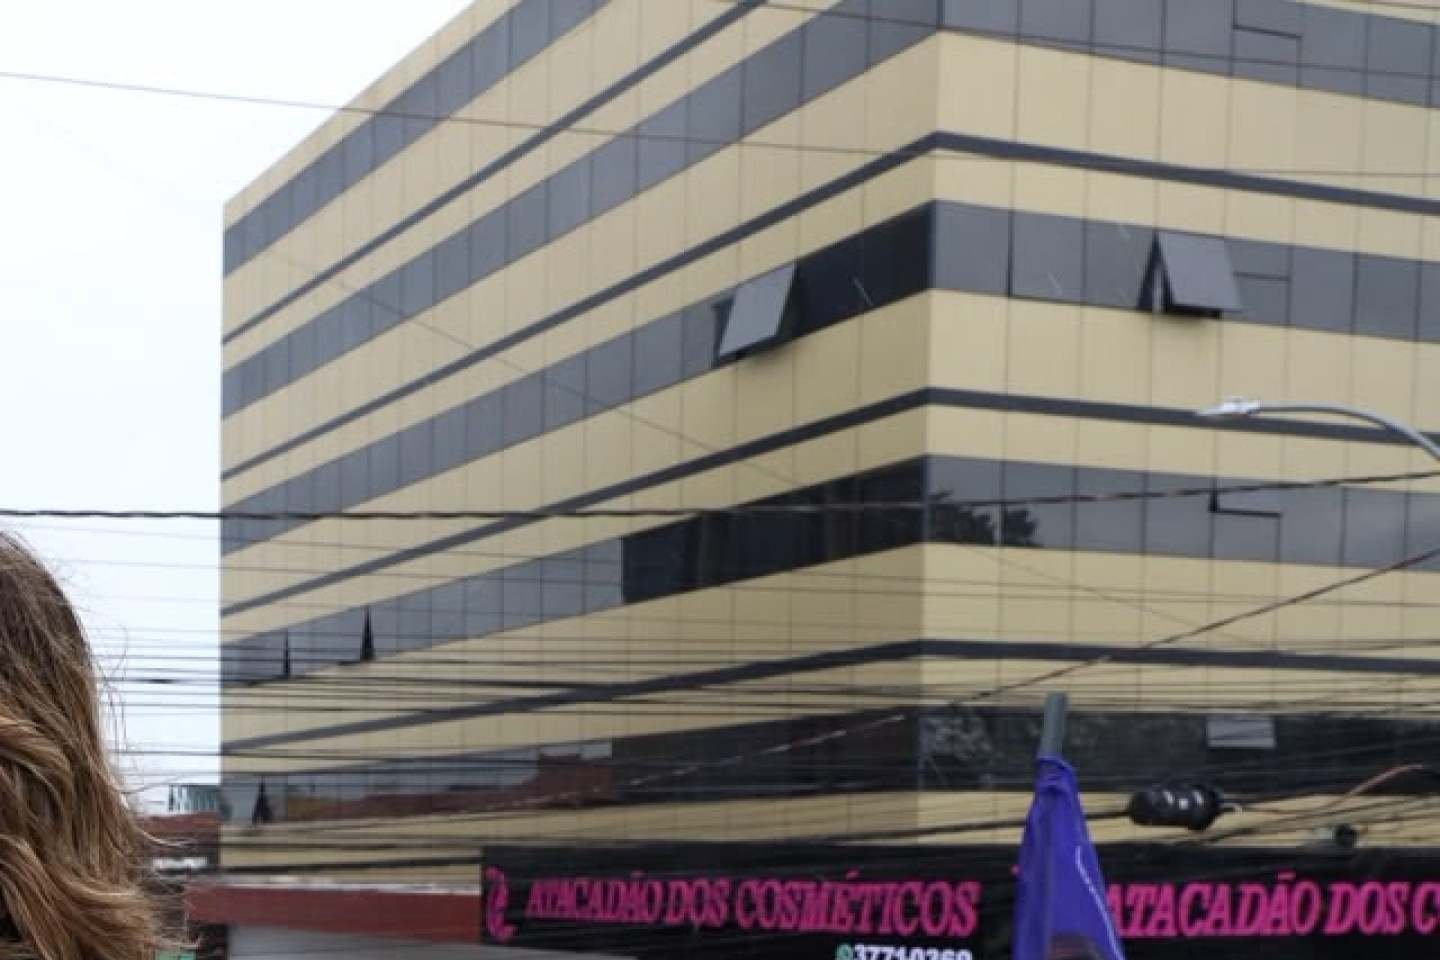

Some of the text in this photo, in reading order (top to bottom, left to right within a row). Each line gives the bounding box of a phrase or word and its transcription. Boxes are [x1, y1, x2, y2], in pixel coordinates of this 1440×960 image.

[665, 879, 730, 928] DOS
[735, 869, 981, 936] COSMÉTICOS
[1324, 881, 1410, 936] DOS
